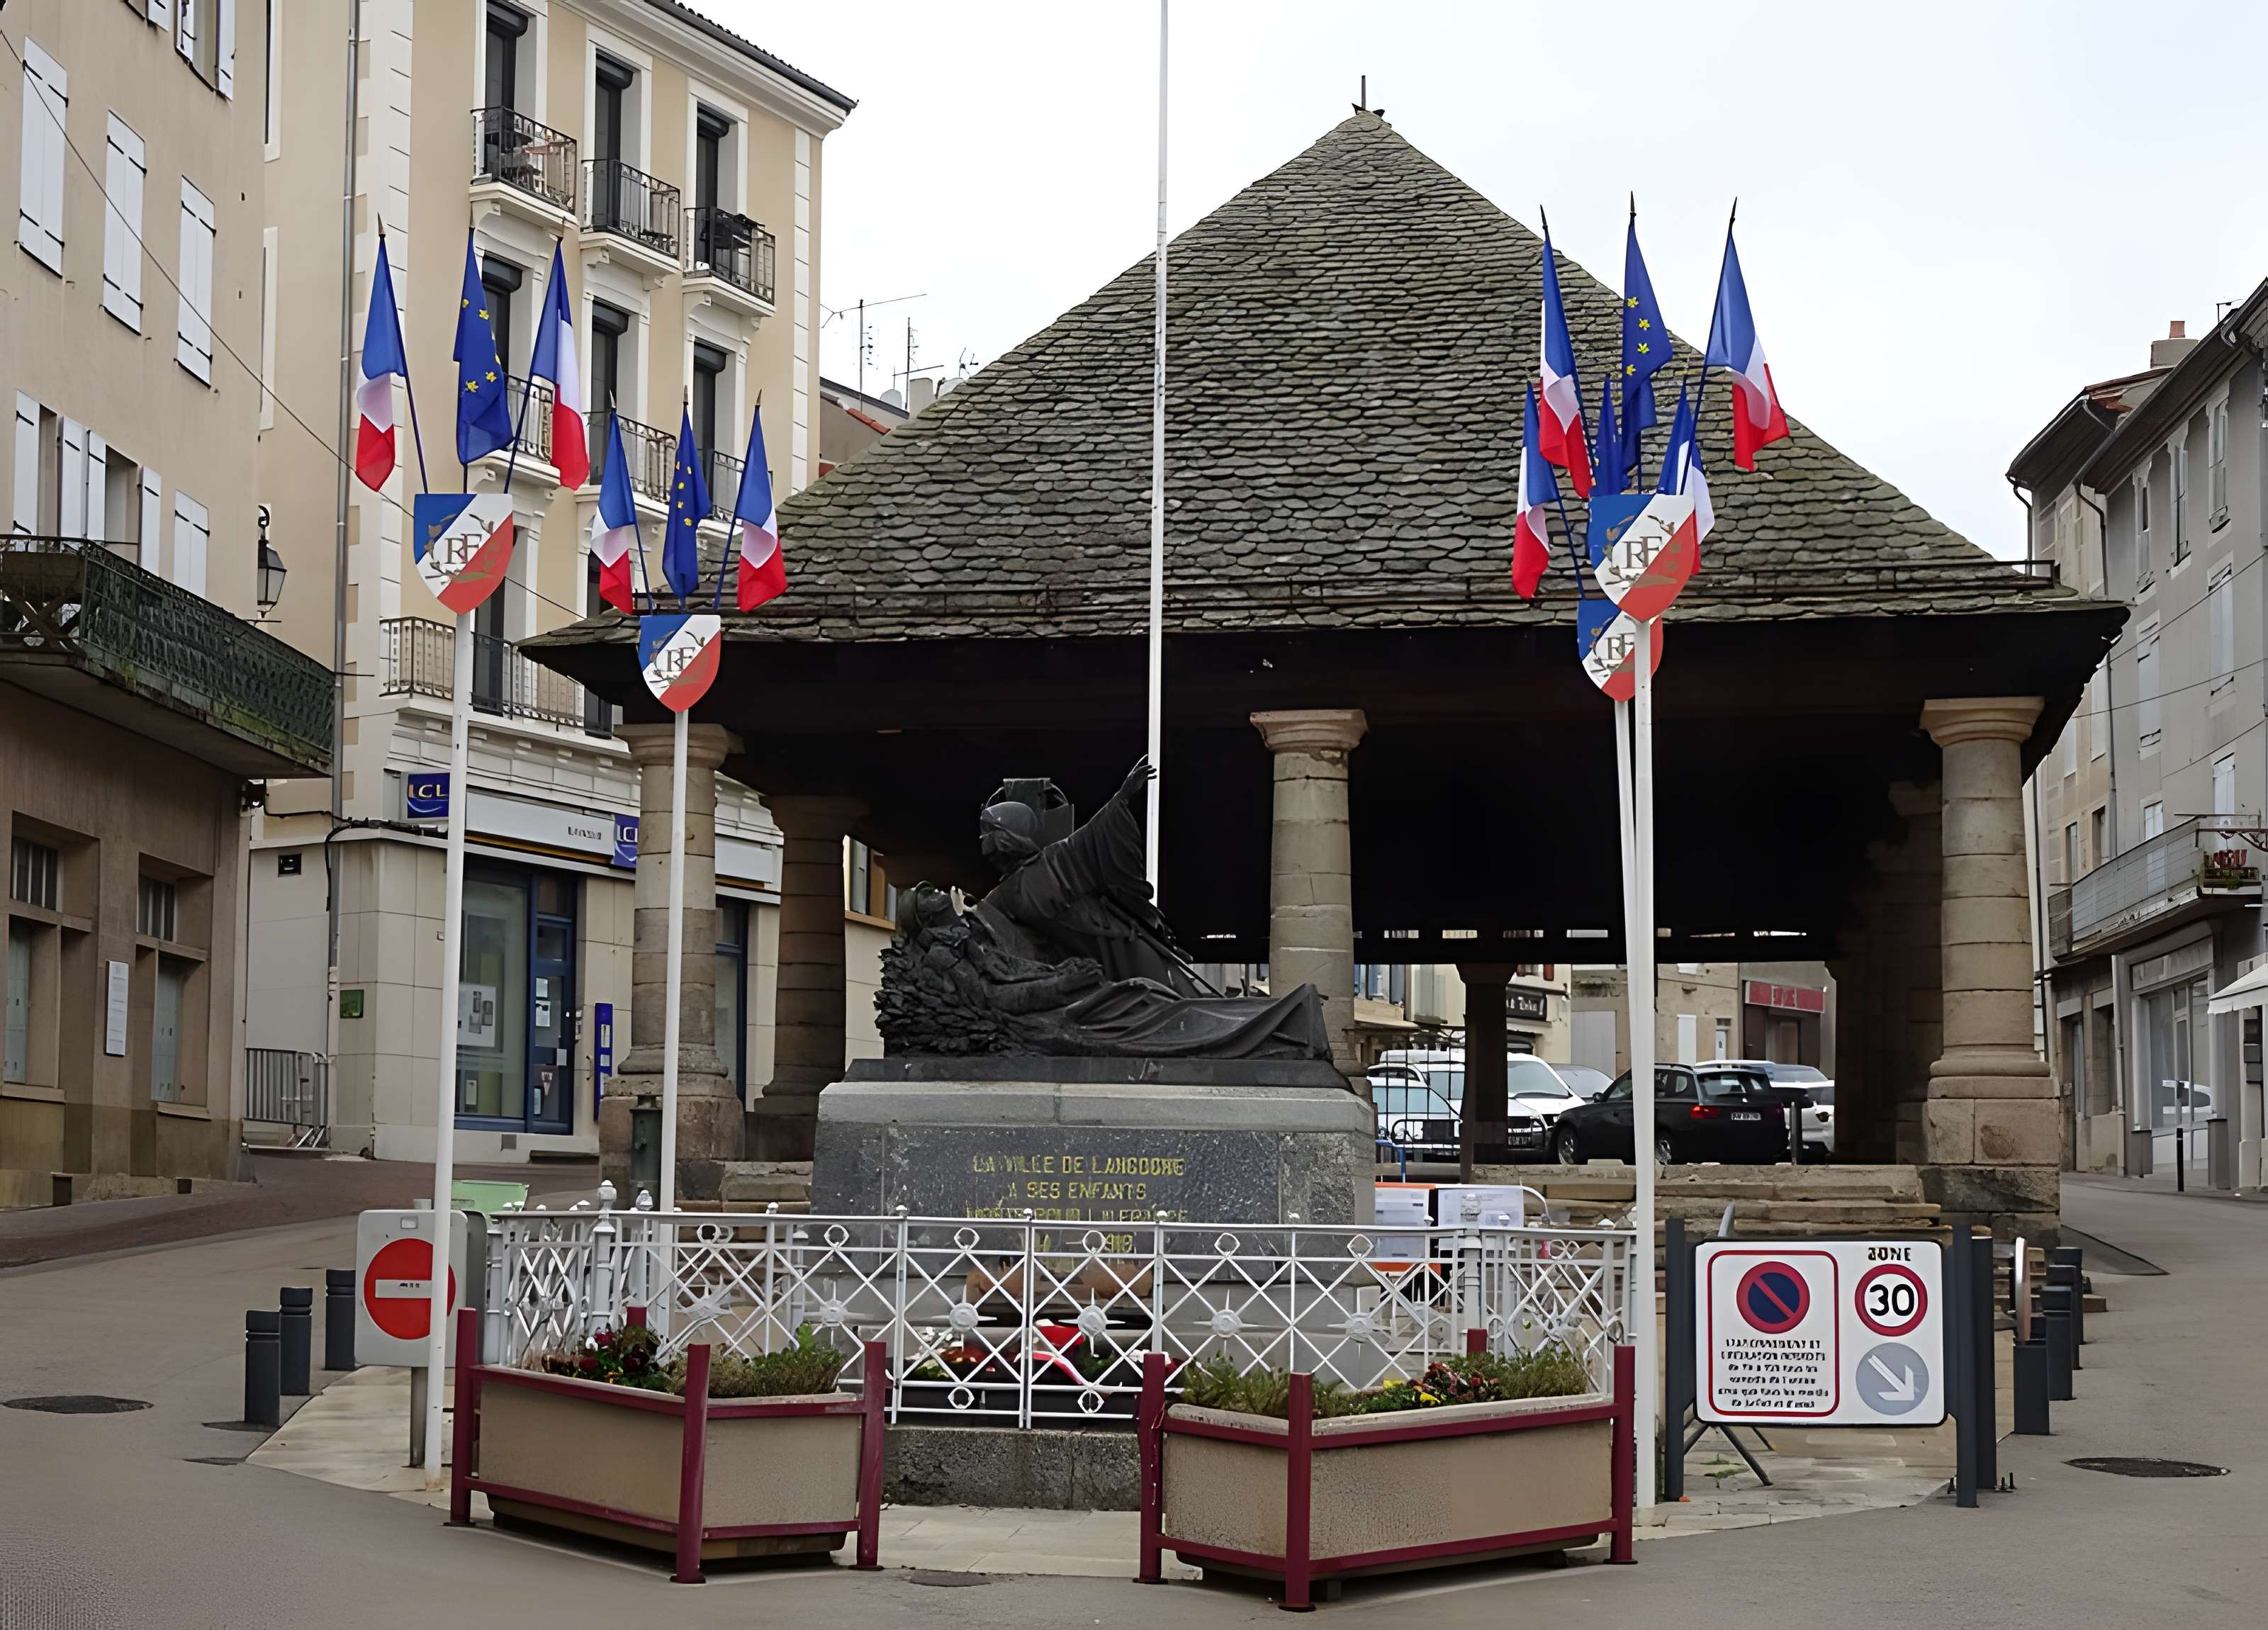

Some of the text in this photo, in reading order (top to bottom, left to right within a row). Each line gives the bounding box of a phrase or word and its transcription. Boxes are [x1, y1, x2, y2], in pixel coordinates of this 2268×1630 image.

[409, 784, 449, 799] LCL
[1062, 1156, 1084, 1174] DE
[1027, 1181, 1061, 1199] SES
[1869, 1283, 1915, 1317] 30
